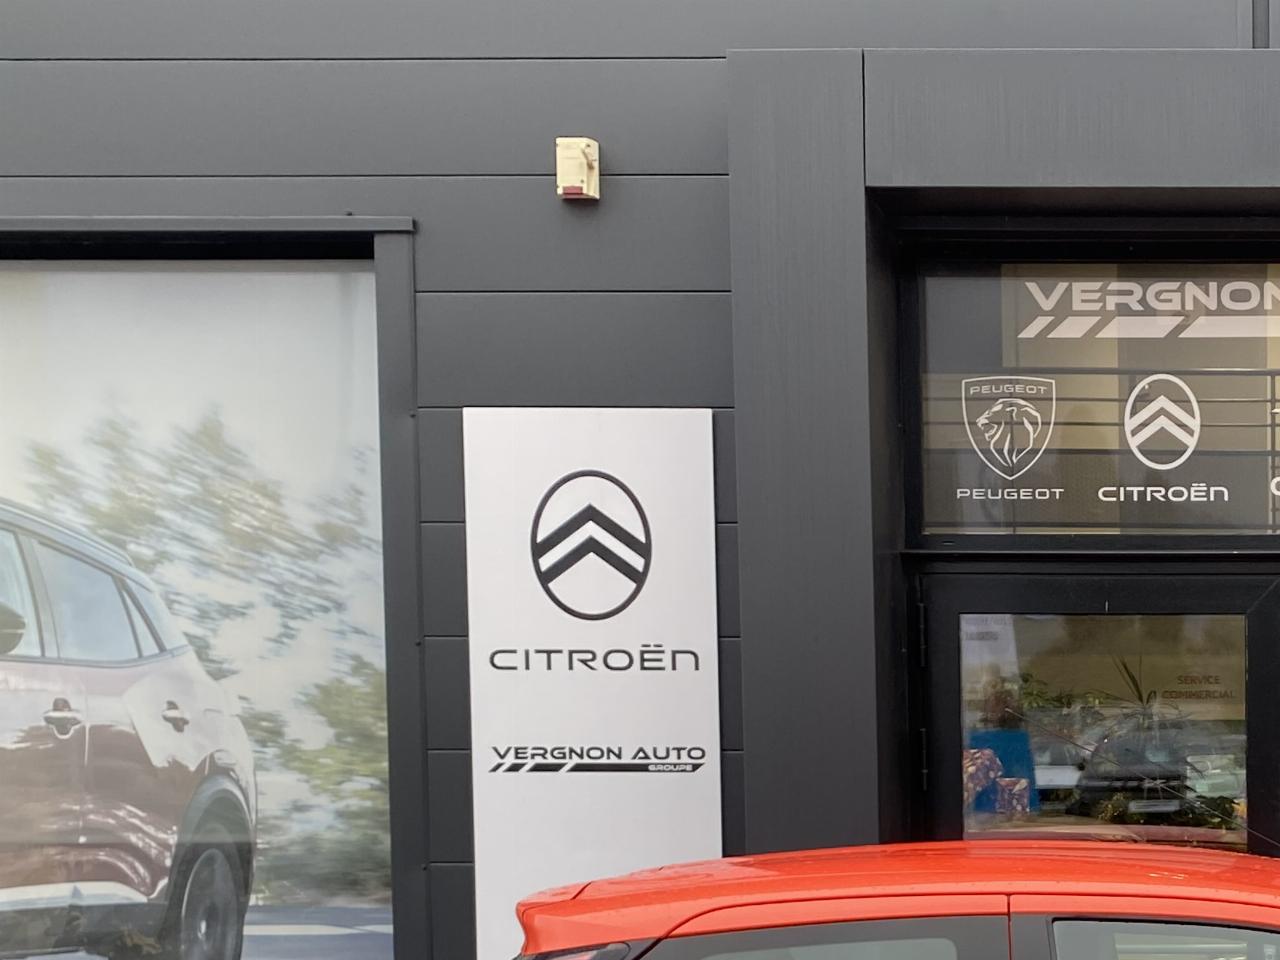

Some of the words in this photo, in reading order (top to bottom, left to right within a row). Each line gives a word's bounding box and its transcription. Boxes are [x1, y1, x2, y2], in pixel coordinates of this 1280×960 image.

[969, 383, 1048, 396] PEUGEOT
[956, 488, 1065, 500] PEUGEOT
[491, 746, 623, 760] VERGNON
[631, 746, 706, 761] AUTO
[648, 764, 693, 772] GROUPE
